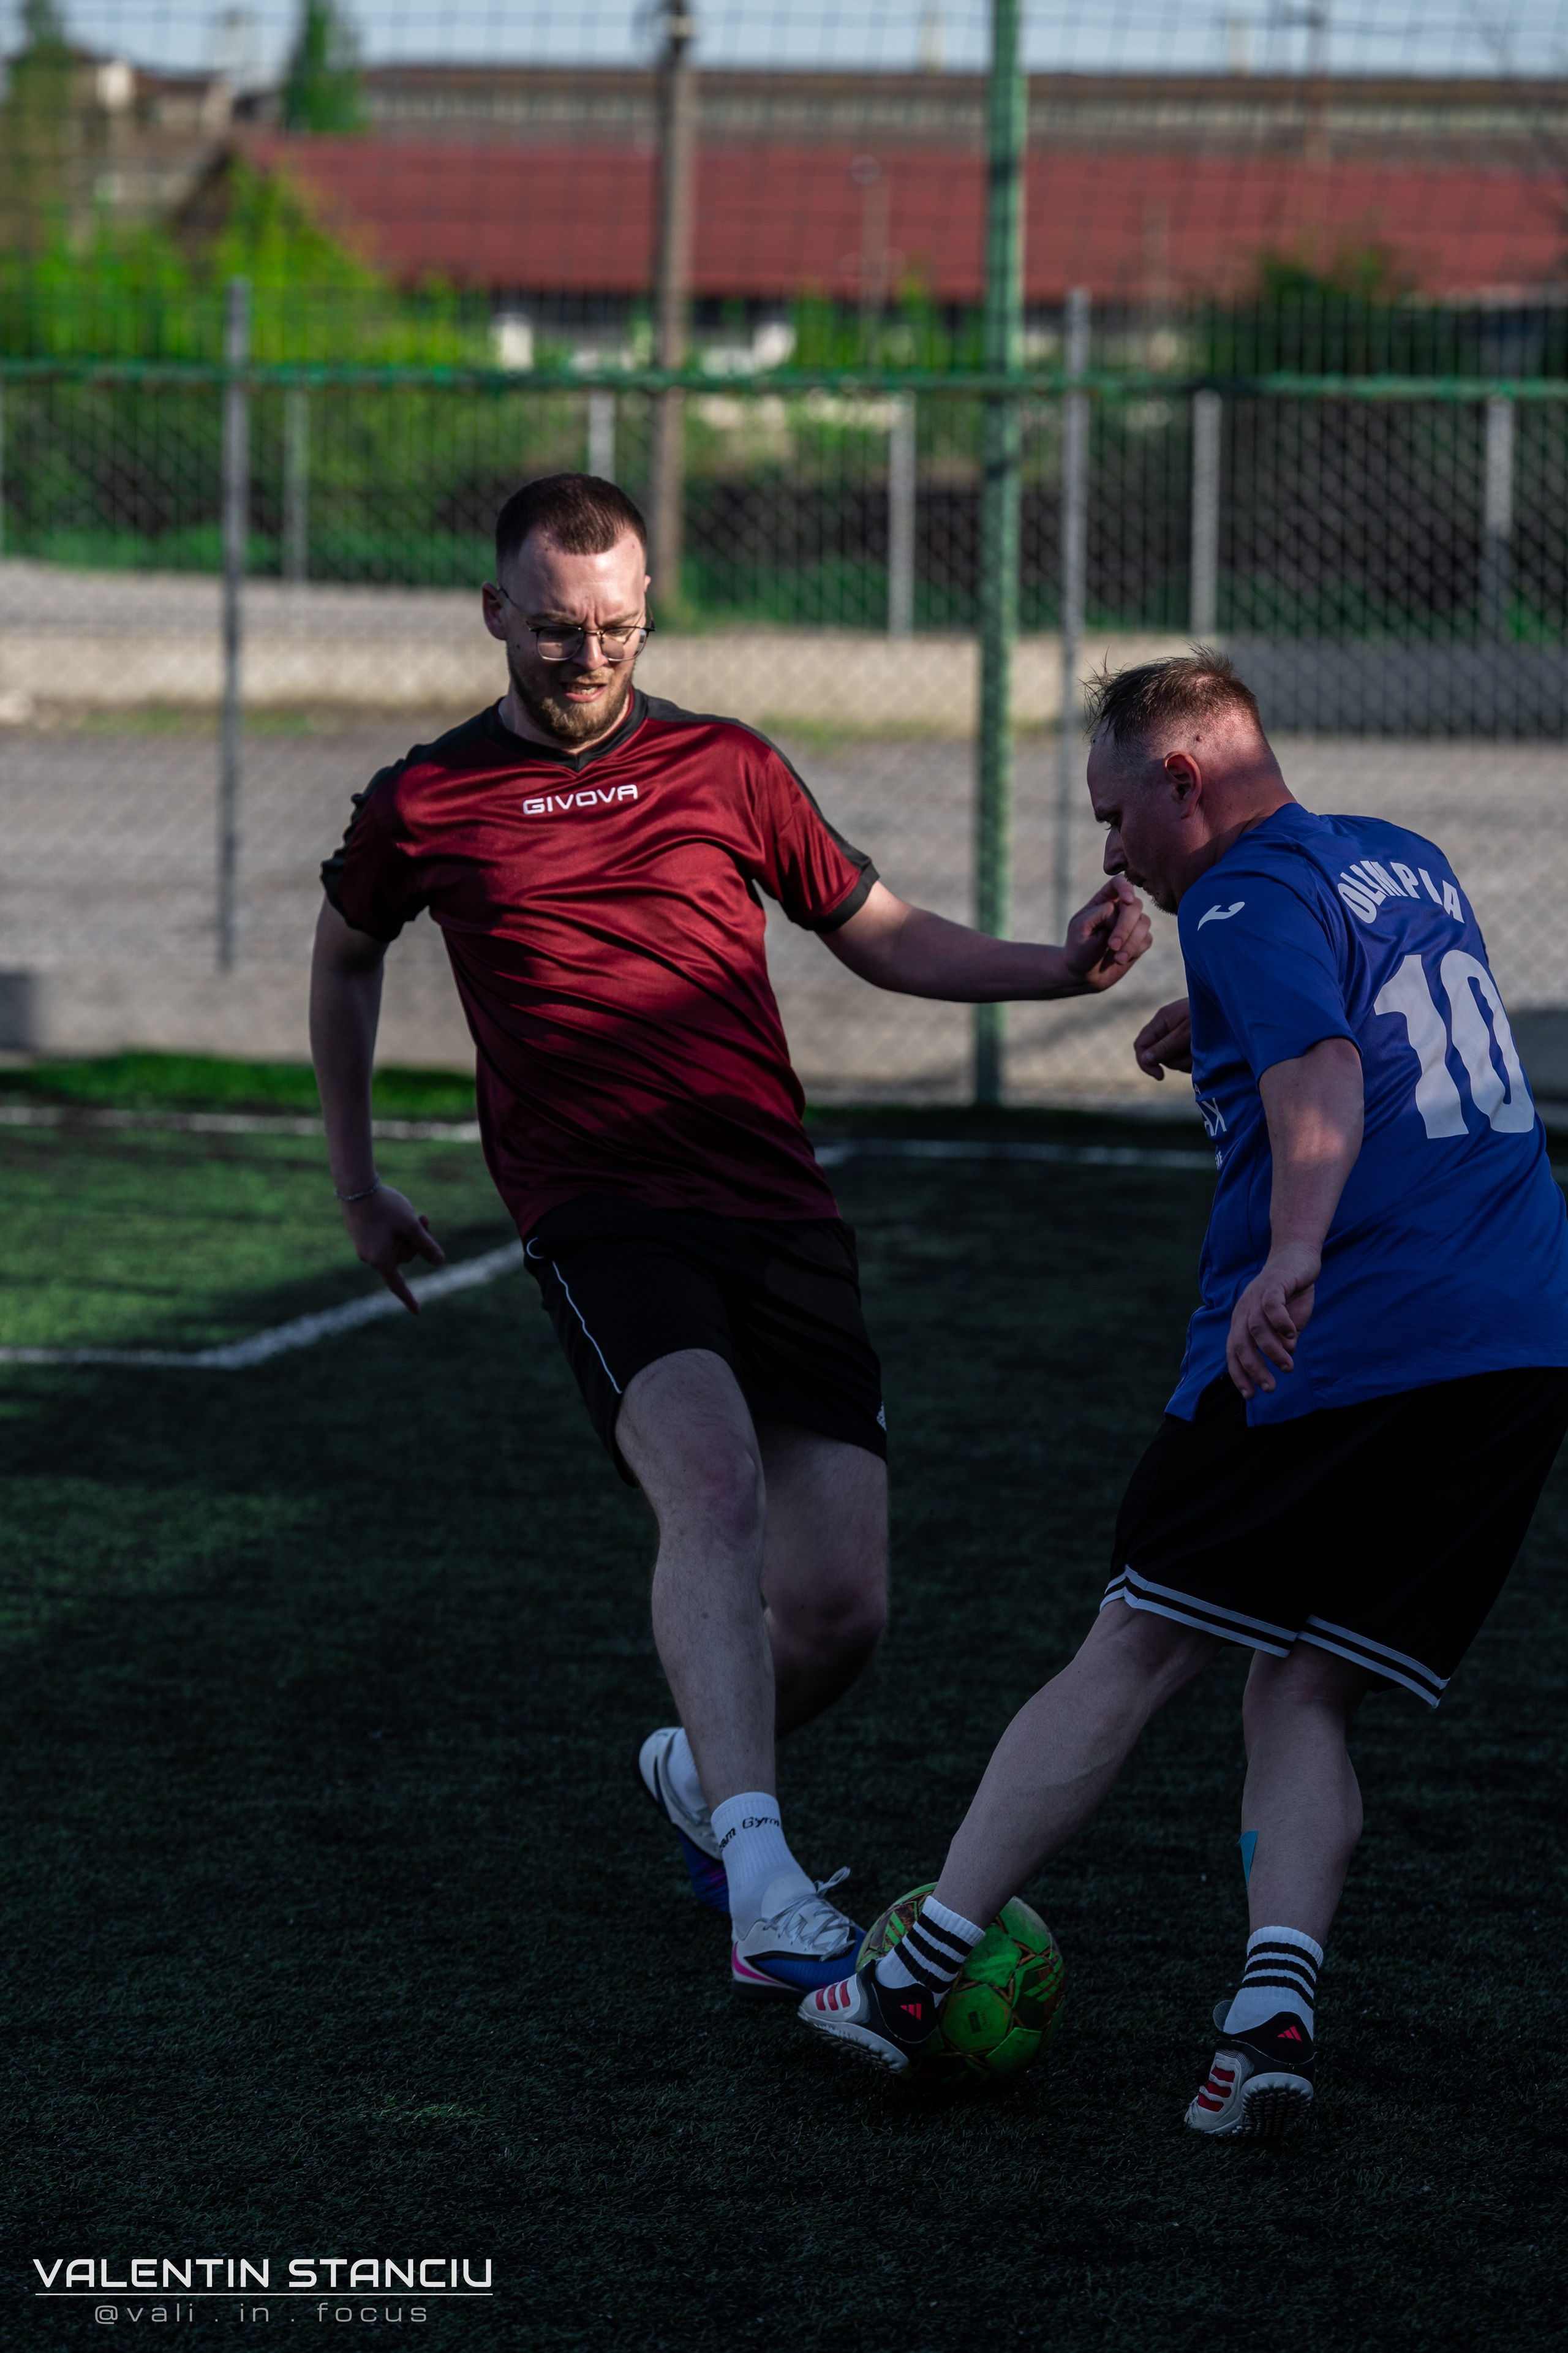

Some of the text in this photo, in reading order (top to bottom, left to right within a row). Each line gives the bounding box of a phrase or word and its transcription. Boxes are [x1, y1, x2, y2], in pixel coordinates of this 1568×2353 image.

[523, 784, 638, 815] GIVOVA
[1337, 860, 1465, 924] OLIMPIA
[1373, 950, 1535, 1139] 10
